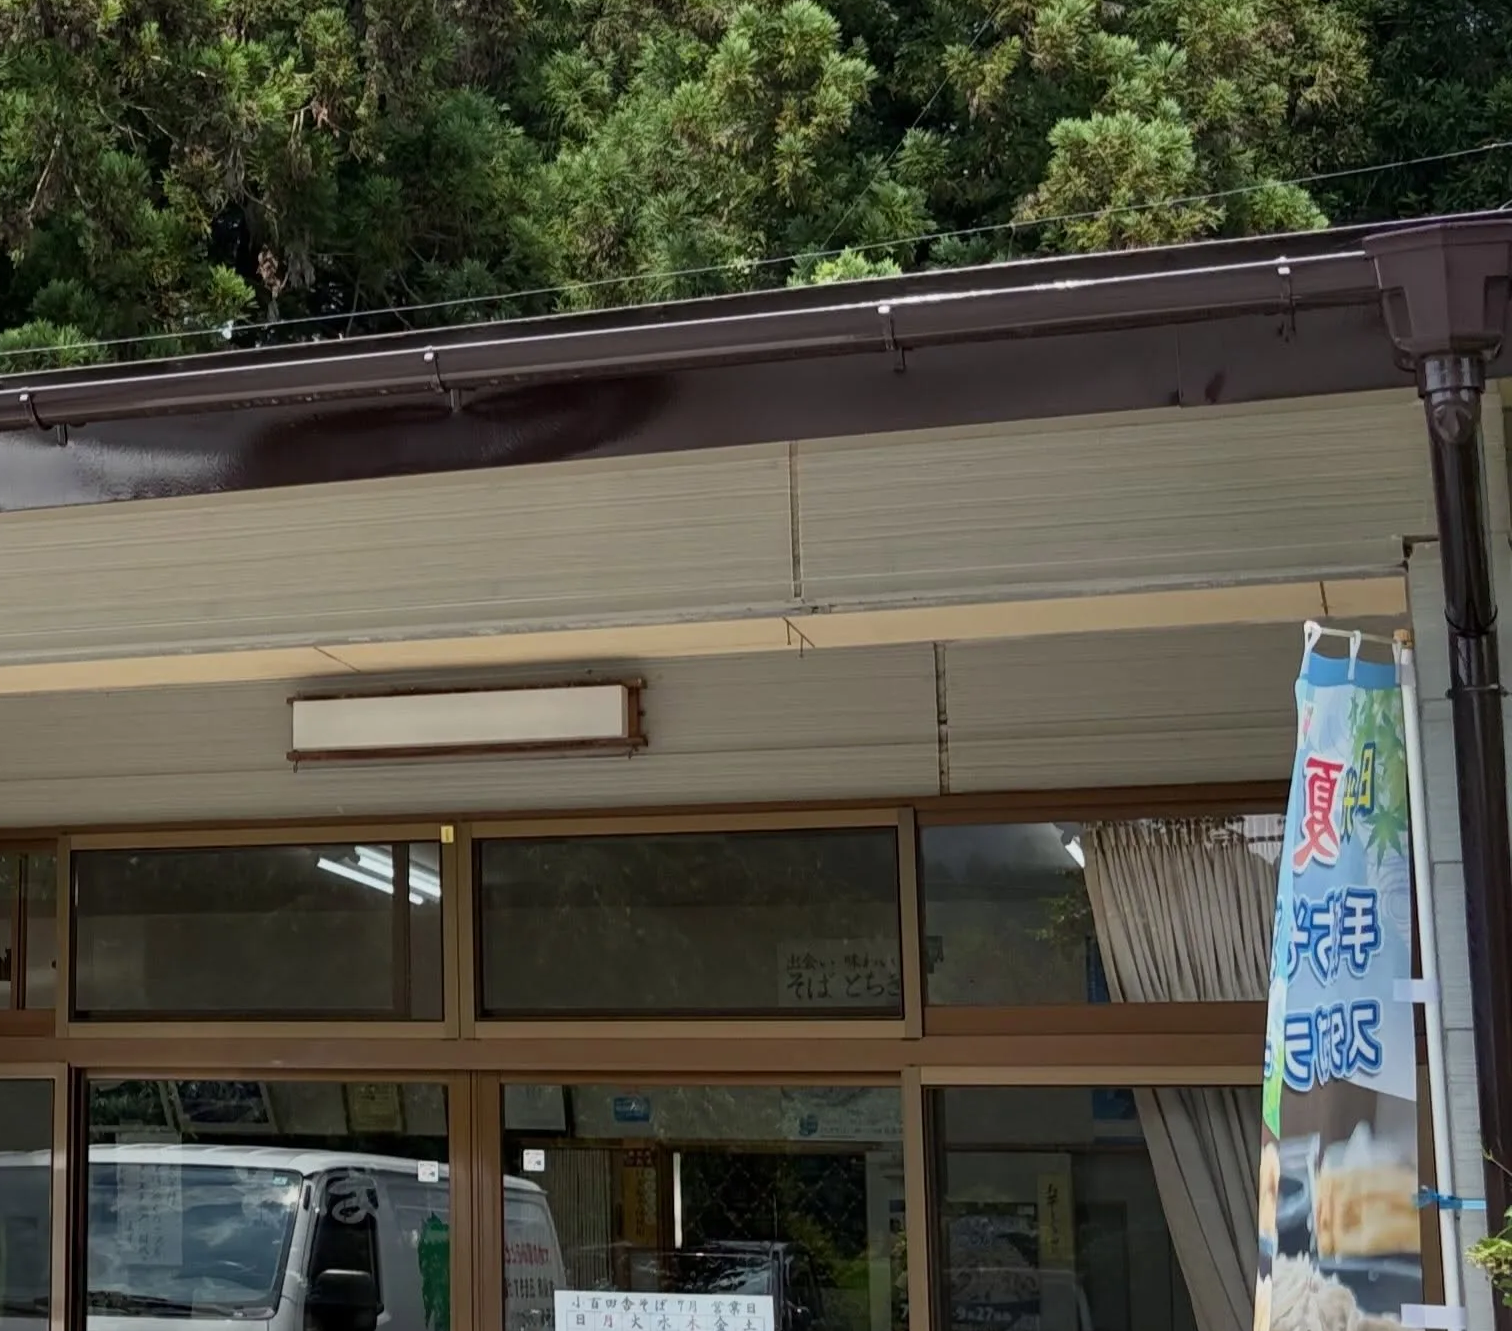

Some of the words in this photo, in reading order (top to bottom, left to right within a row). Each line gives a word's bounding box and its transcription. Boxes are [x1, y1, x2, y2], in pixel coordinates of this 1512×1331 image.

[787, 971, 835, 1000] そば
[576, 1314, 586, 1326] 日
[603, 1315, 613, 1328] 月
[632, 1314, 643, 1330] 火
[658, 1314, 671, 1330] 水
[688, 1315, 700, 1330] 木
[714, 1316, 728, 1331] 金
[744, 1319, 756, 1331] 土
